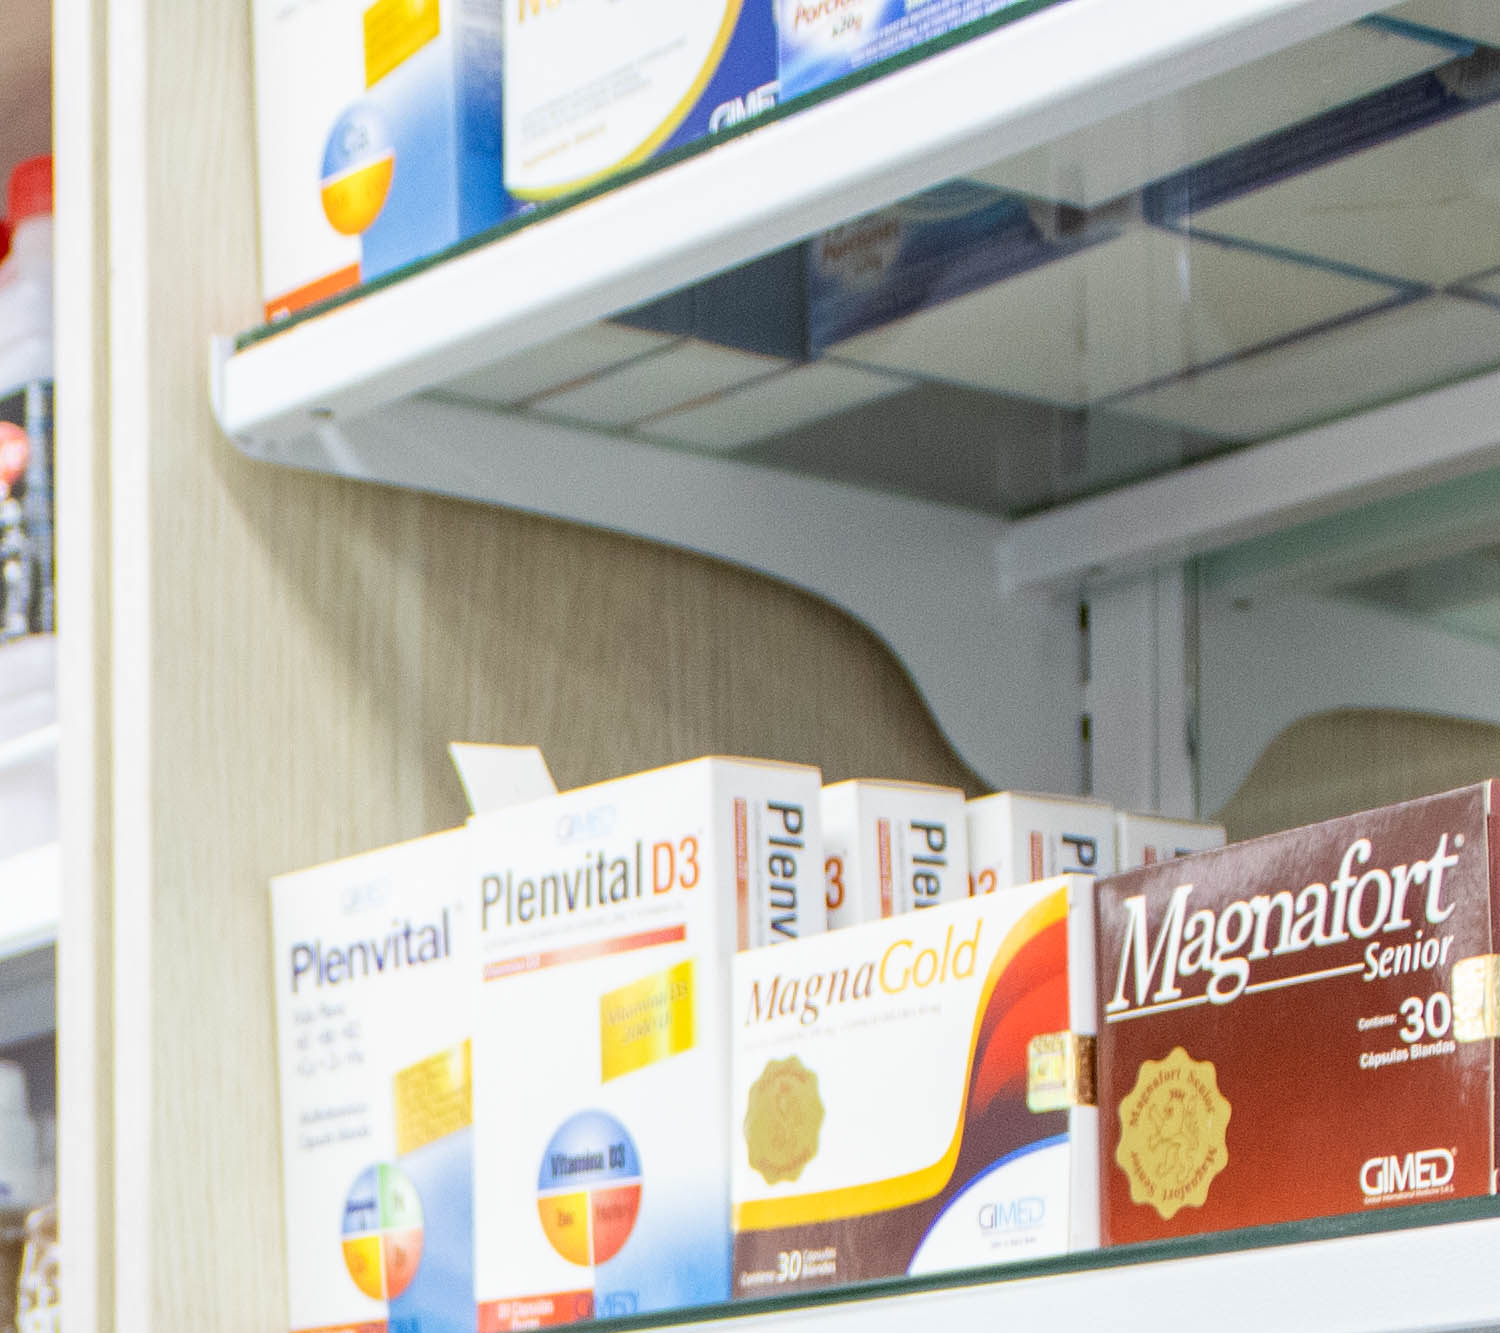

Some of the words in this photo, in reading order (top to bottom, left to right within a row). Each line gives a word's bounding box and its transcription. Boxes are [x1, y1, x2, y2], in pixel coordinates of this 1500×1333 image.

[480, 848, 645, 934] Plenvital
[652, 834, 702, 897] D3
[1106, 834, 1462, 1012] Magnafort
[290, 908, 453, 997] Plenvital
[742, 919, 984, 1030] MagnaGold
[1362, 930, 1455, 982] Senior
[1399, 991, 1452, 1043] 30
[1359, 1046, 1409, 1069] Cápsulas
[1410, 1039, 1456, 1060] Blandas
[1359, 1149, 1455, 1196] GIMED
[977, 1196, 1047, 1239] GIMED
